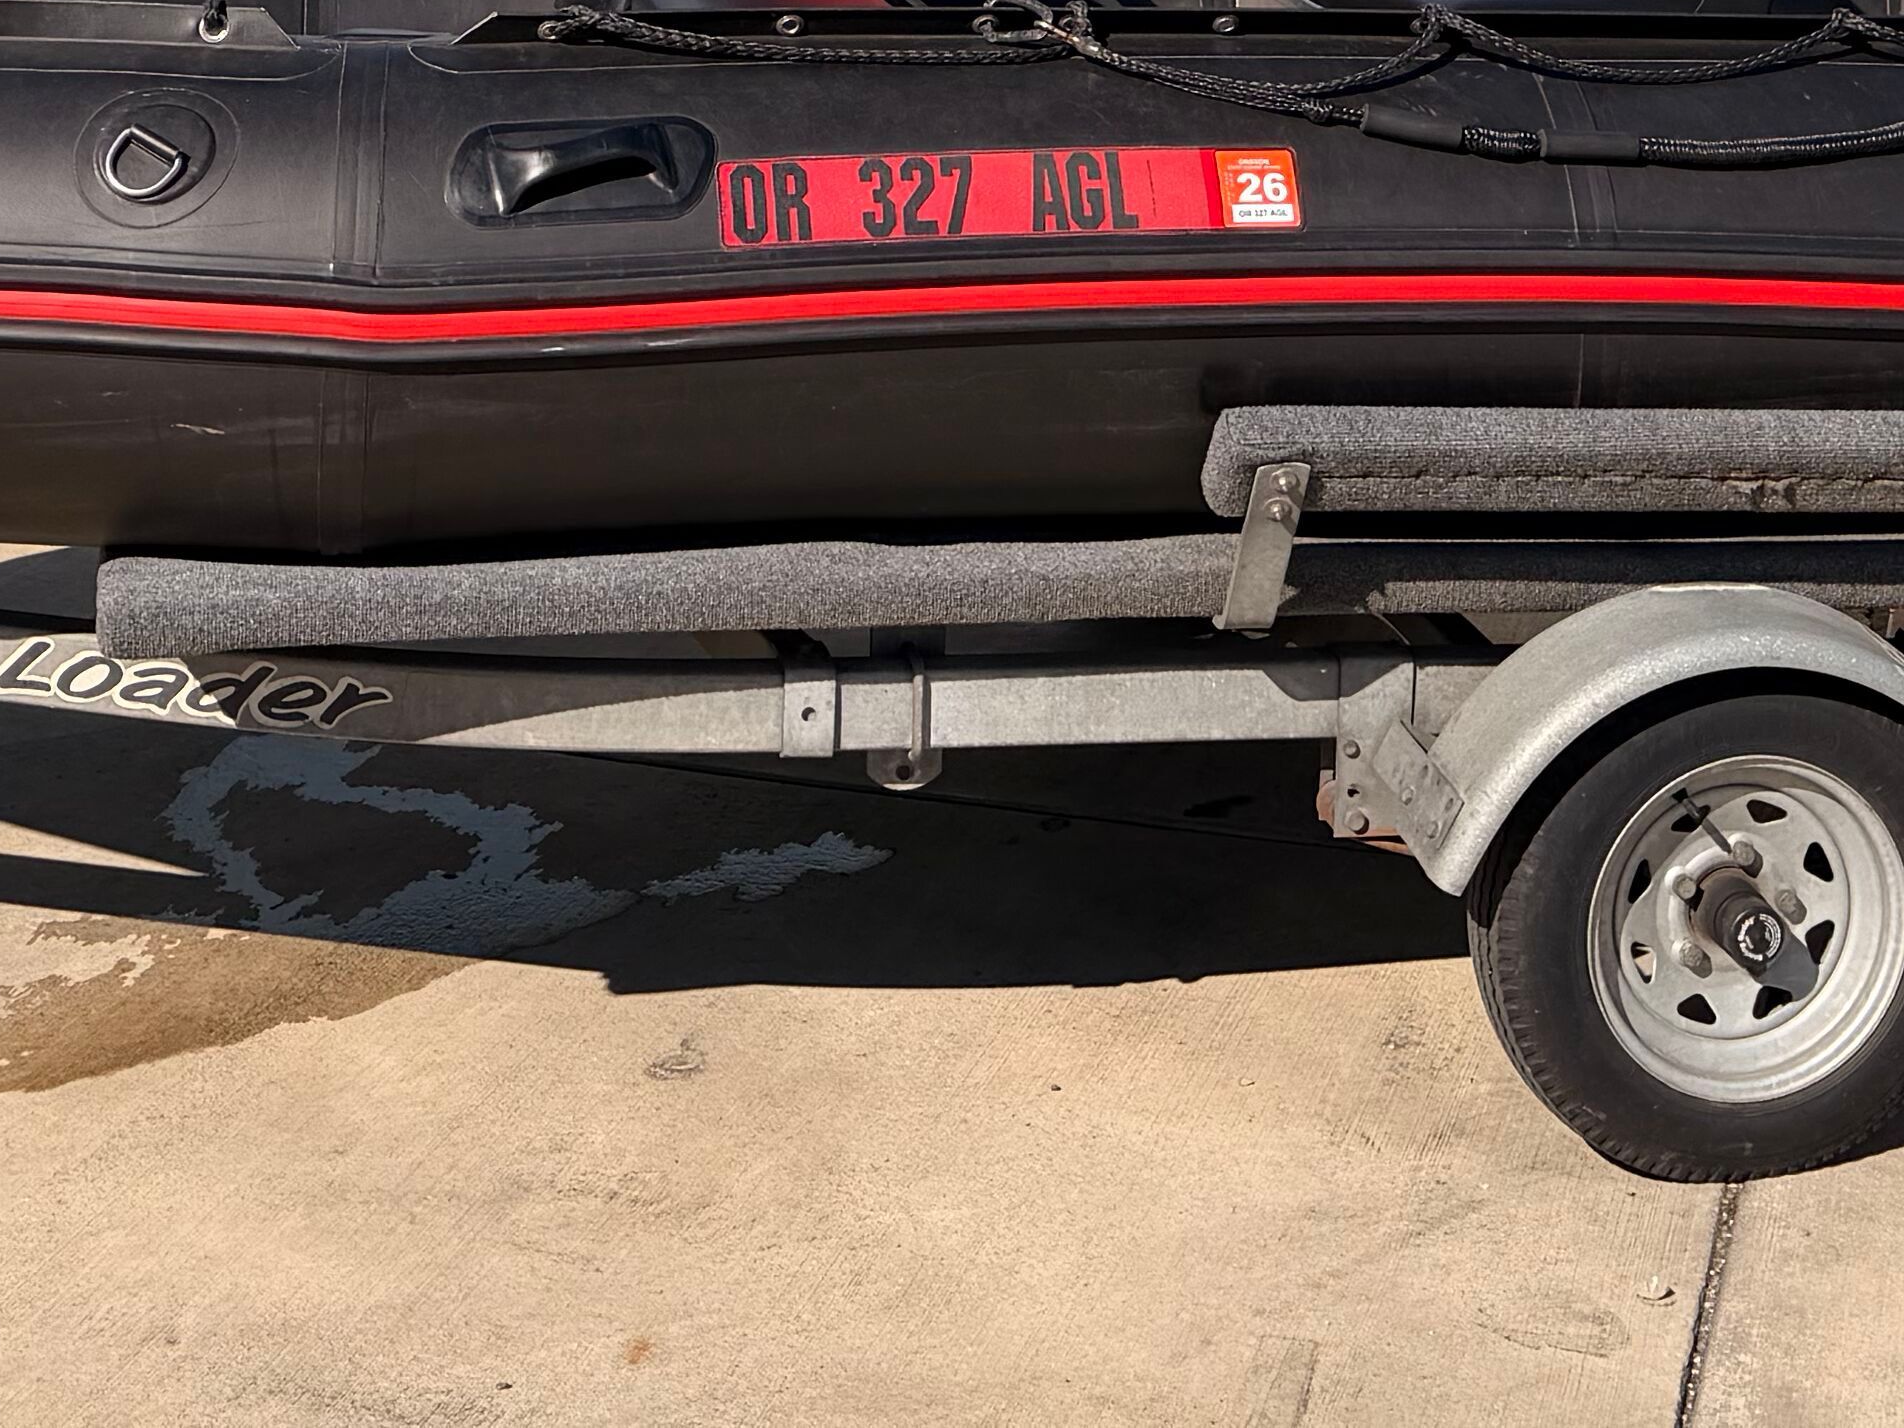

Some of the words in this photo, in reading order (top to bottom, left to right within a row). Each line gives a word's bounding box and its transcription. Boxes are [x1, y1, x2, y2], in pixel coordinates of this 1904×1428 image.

[729, 162, 813, 244] OR
[857, 155, 973, 238] 327
[1032, 151, 1139, 231] AGL
[1237, 172, 1288, 203] 26
